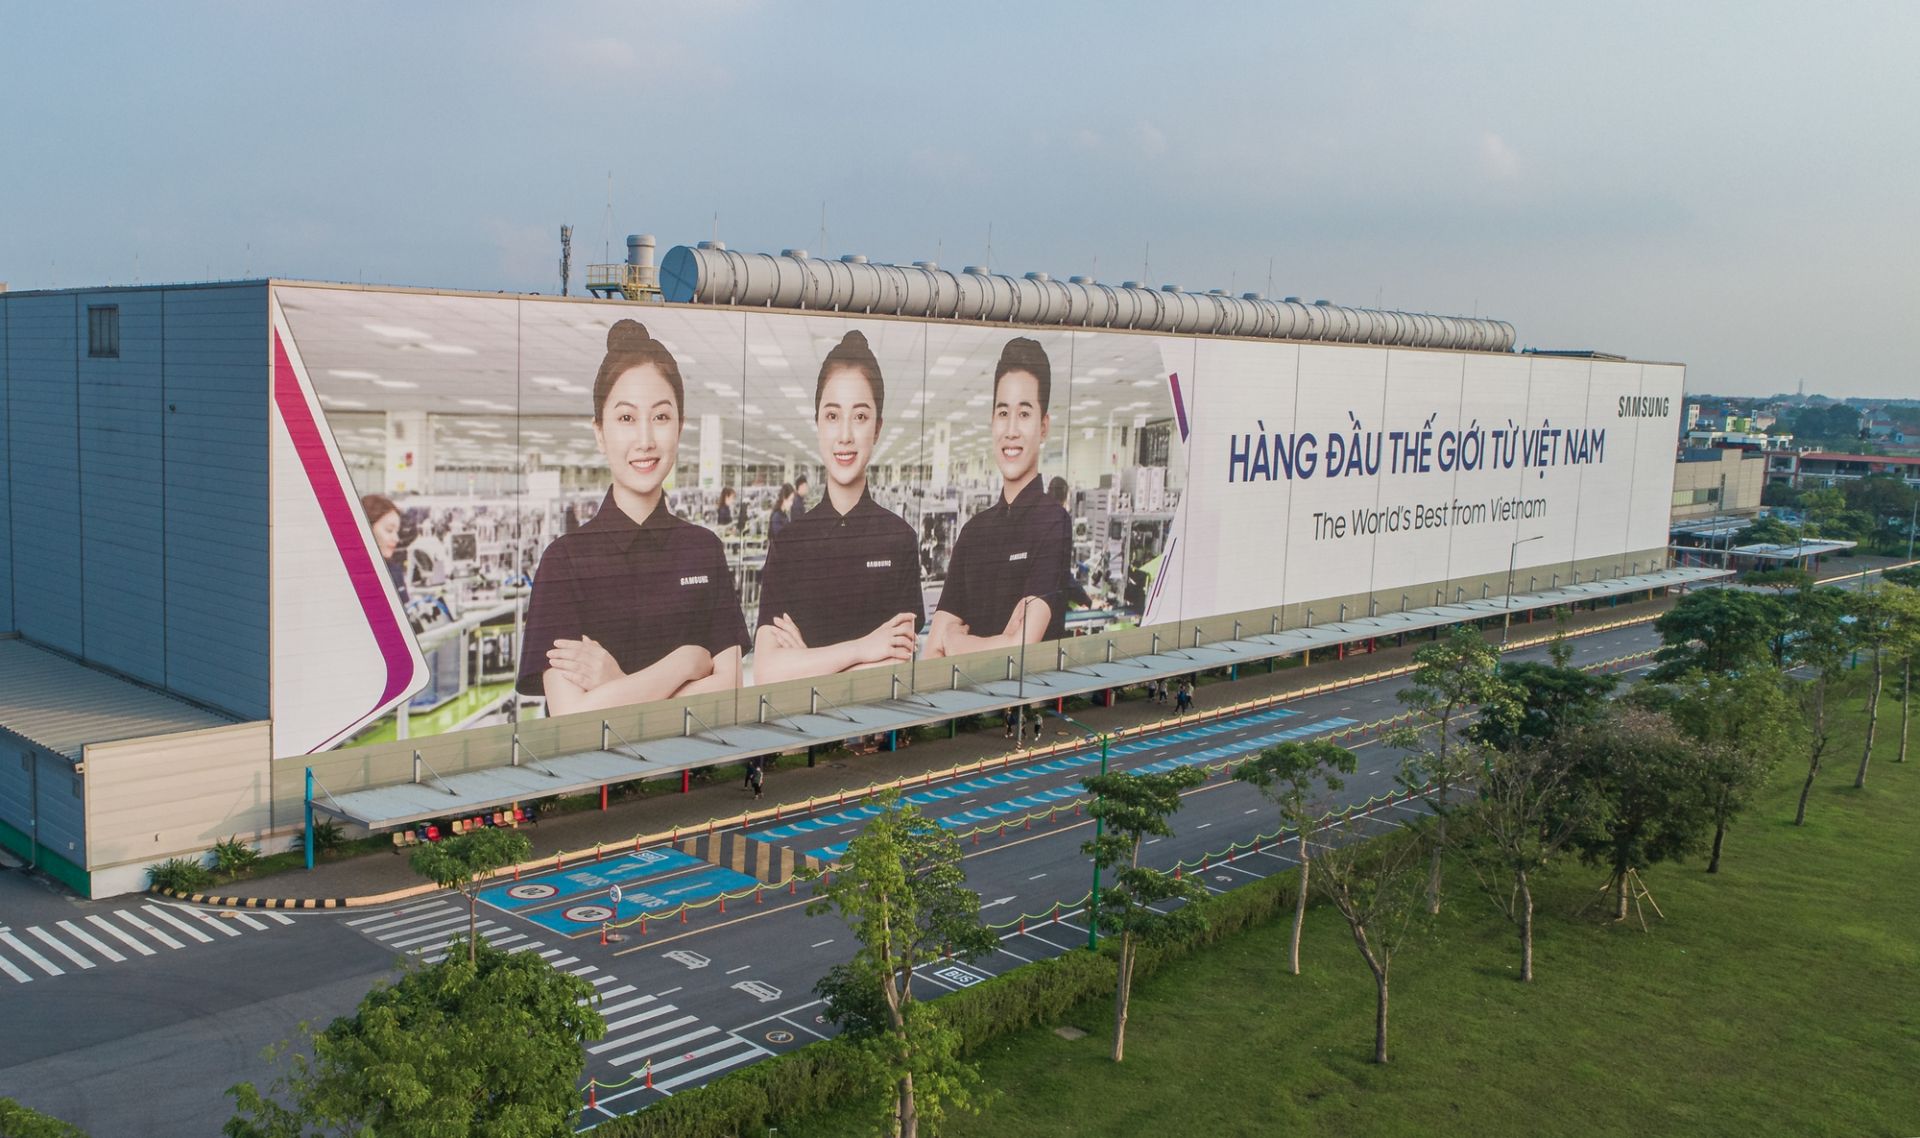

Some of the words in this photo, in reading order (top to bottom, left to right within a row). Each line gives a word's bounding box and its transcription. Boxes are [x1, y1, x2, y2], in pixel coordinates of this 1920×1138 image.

[1618, 396, 1670, 418] SAMSUNG
[1228, 420, 1318, 483] HÀNG
[1325, 411, 1382, 478] ĐẦU
[1389, 413, 1437, 474] THẾ
[1437, 419, 1485, 472] GIỚI
[1491, 419, 1520, 469] TỪ
[1522, 419, 1562, 479] VIỆT
[1564, 428, 1606, 466] NAM
[1313, 512, 1346, 541] The
[1351, 505, 1411, 536] World's
[1414, 502, 1448, 530] Best
[1451, 499, 1486, 526] from
[1490, 496, 1547, 522] Vietnam
[944, 970, 974, 983] BUS
